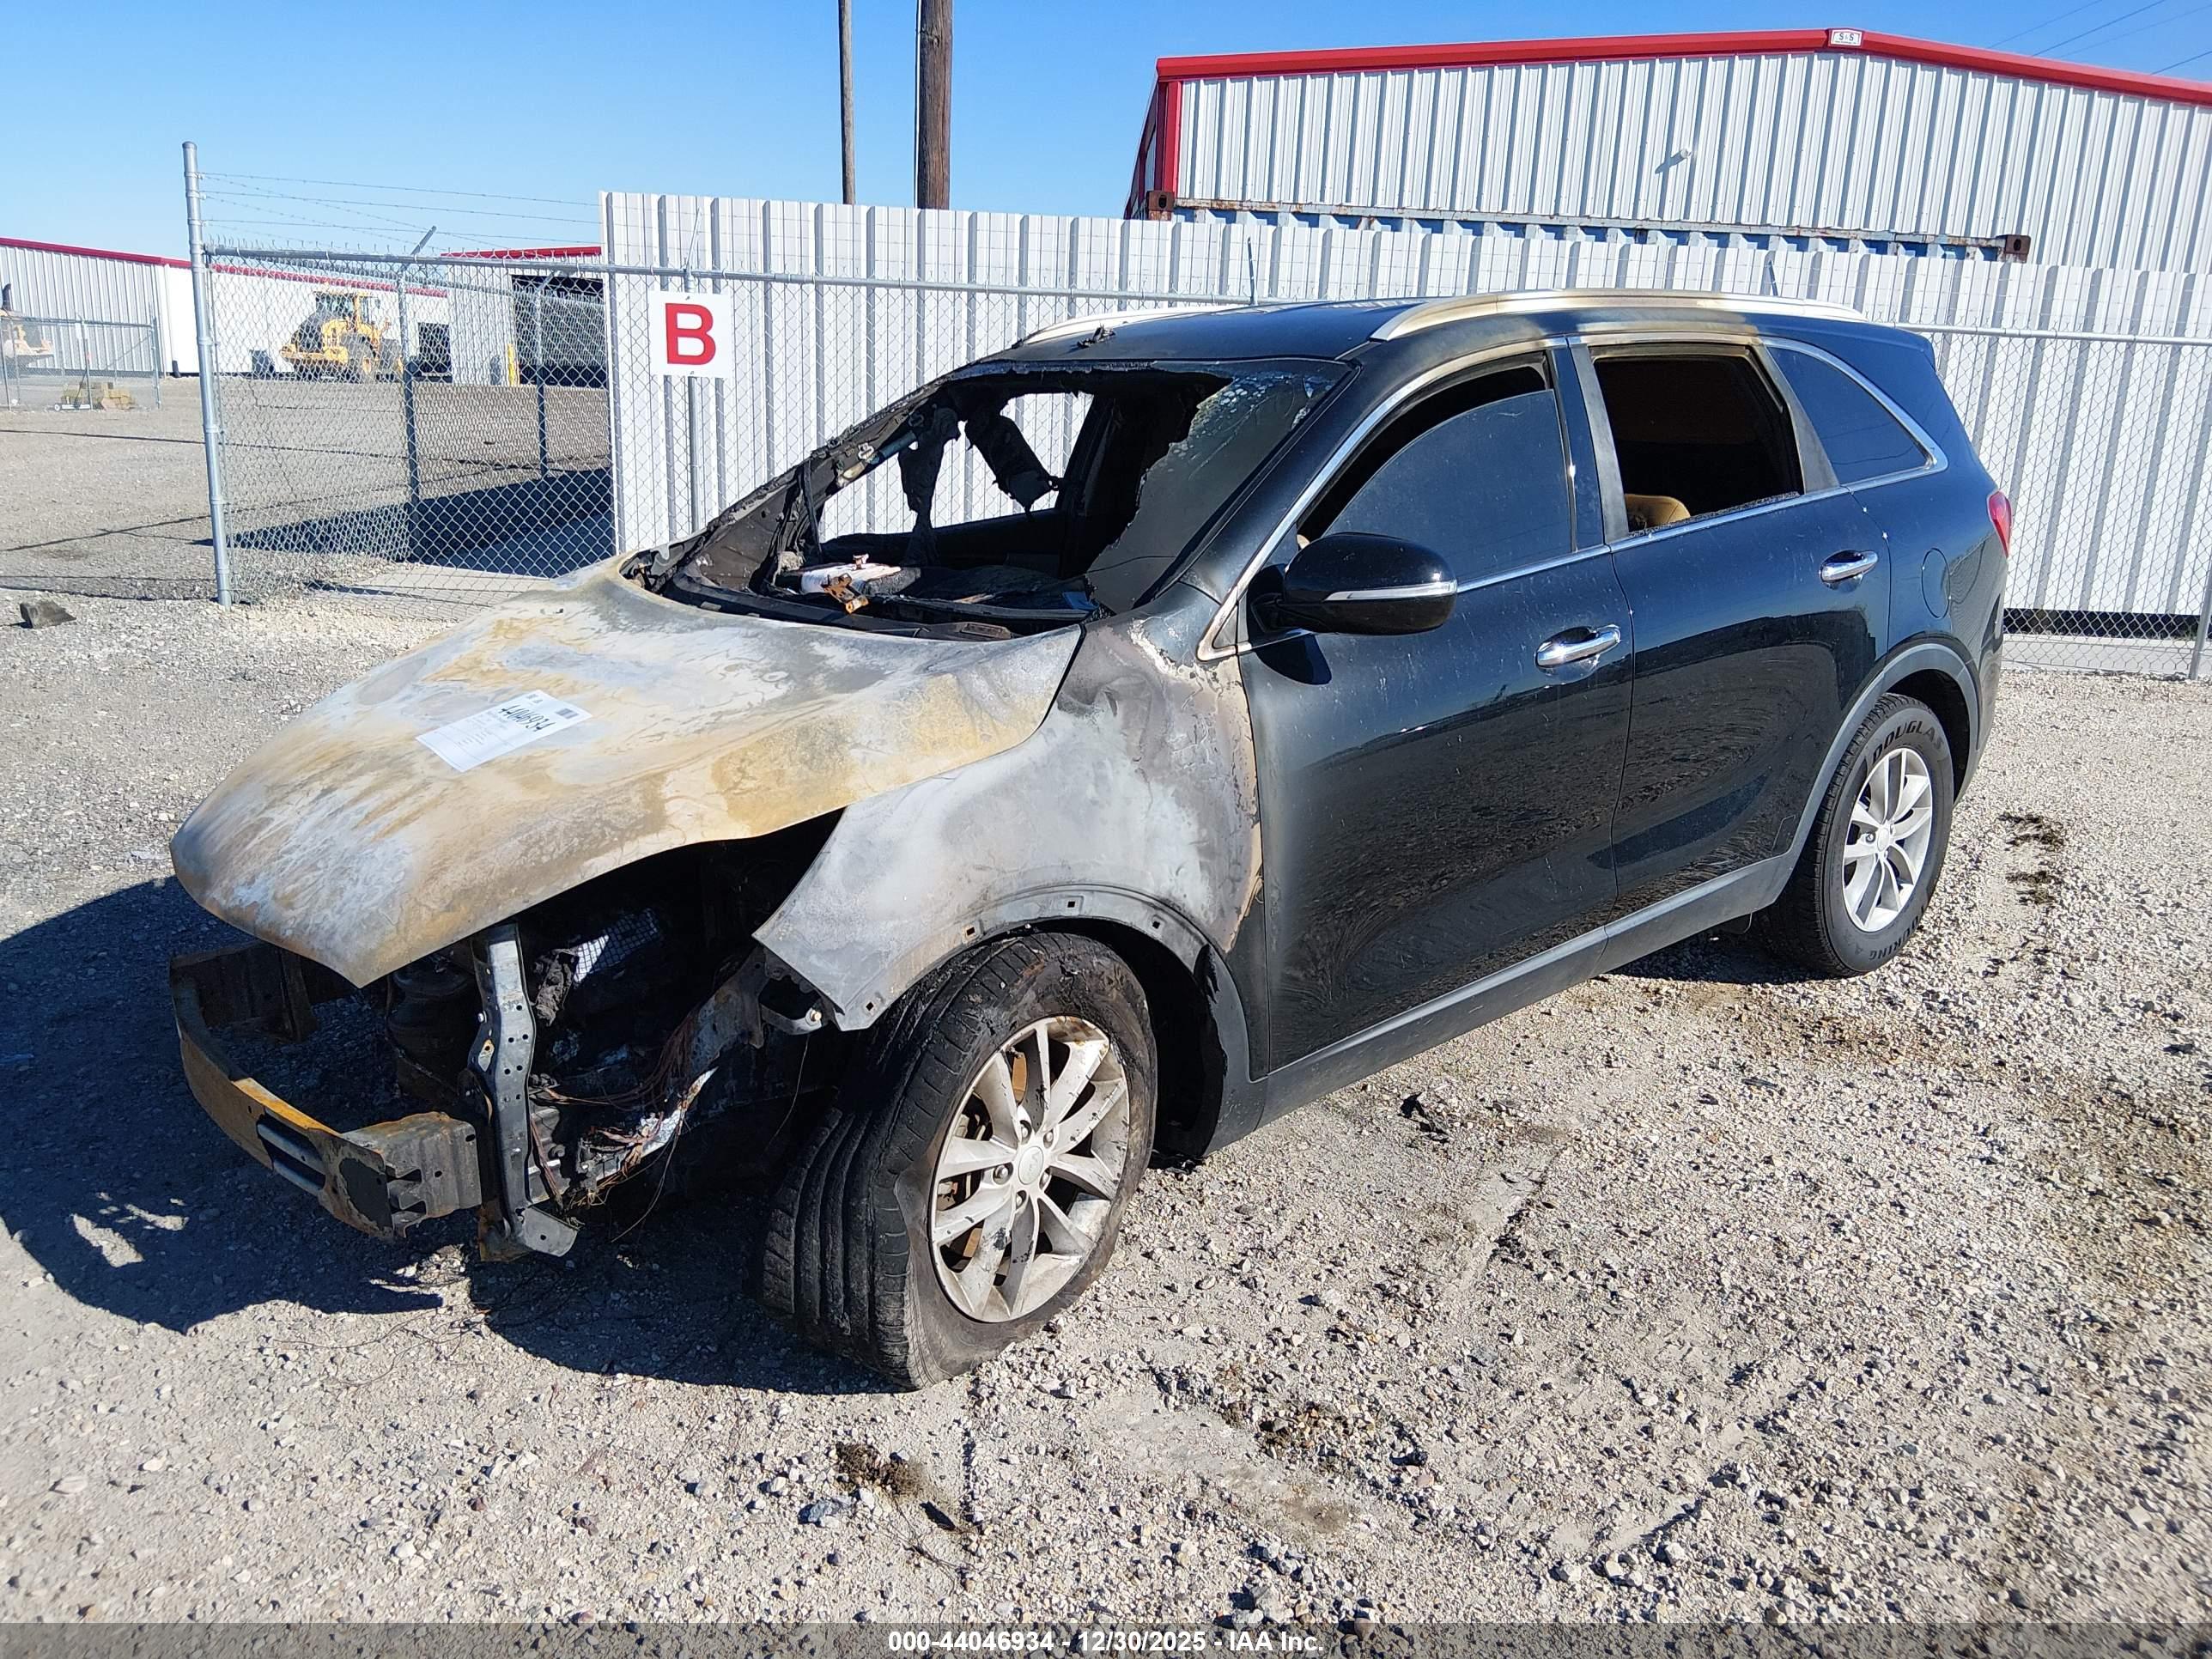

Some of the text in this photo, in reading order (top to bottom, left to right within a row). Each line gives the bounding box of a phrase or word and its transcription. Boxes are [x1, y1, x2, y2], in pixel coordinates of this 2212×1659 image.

[665, 303, 716, 365] B
[498, 704, 556, 732] 44046934
[1872, 720, 1944, 764] DOUGLAS
